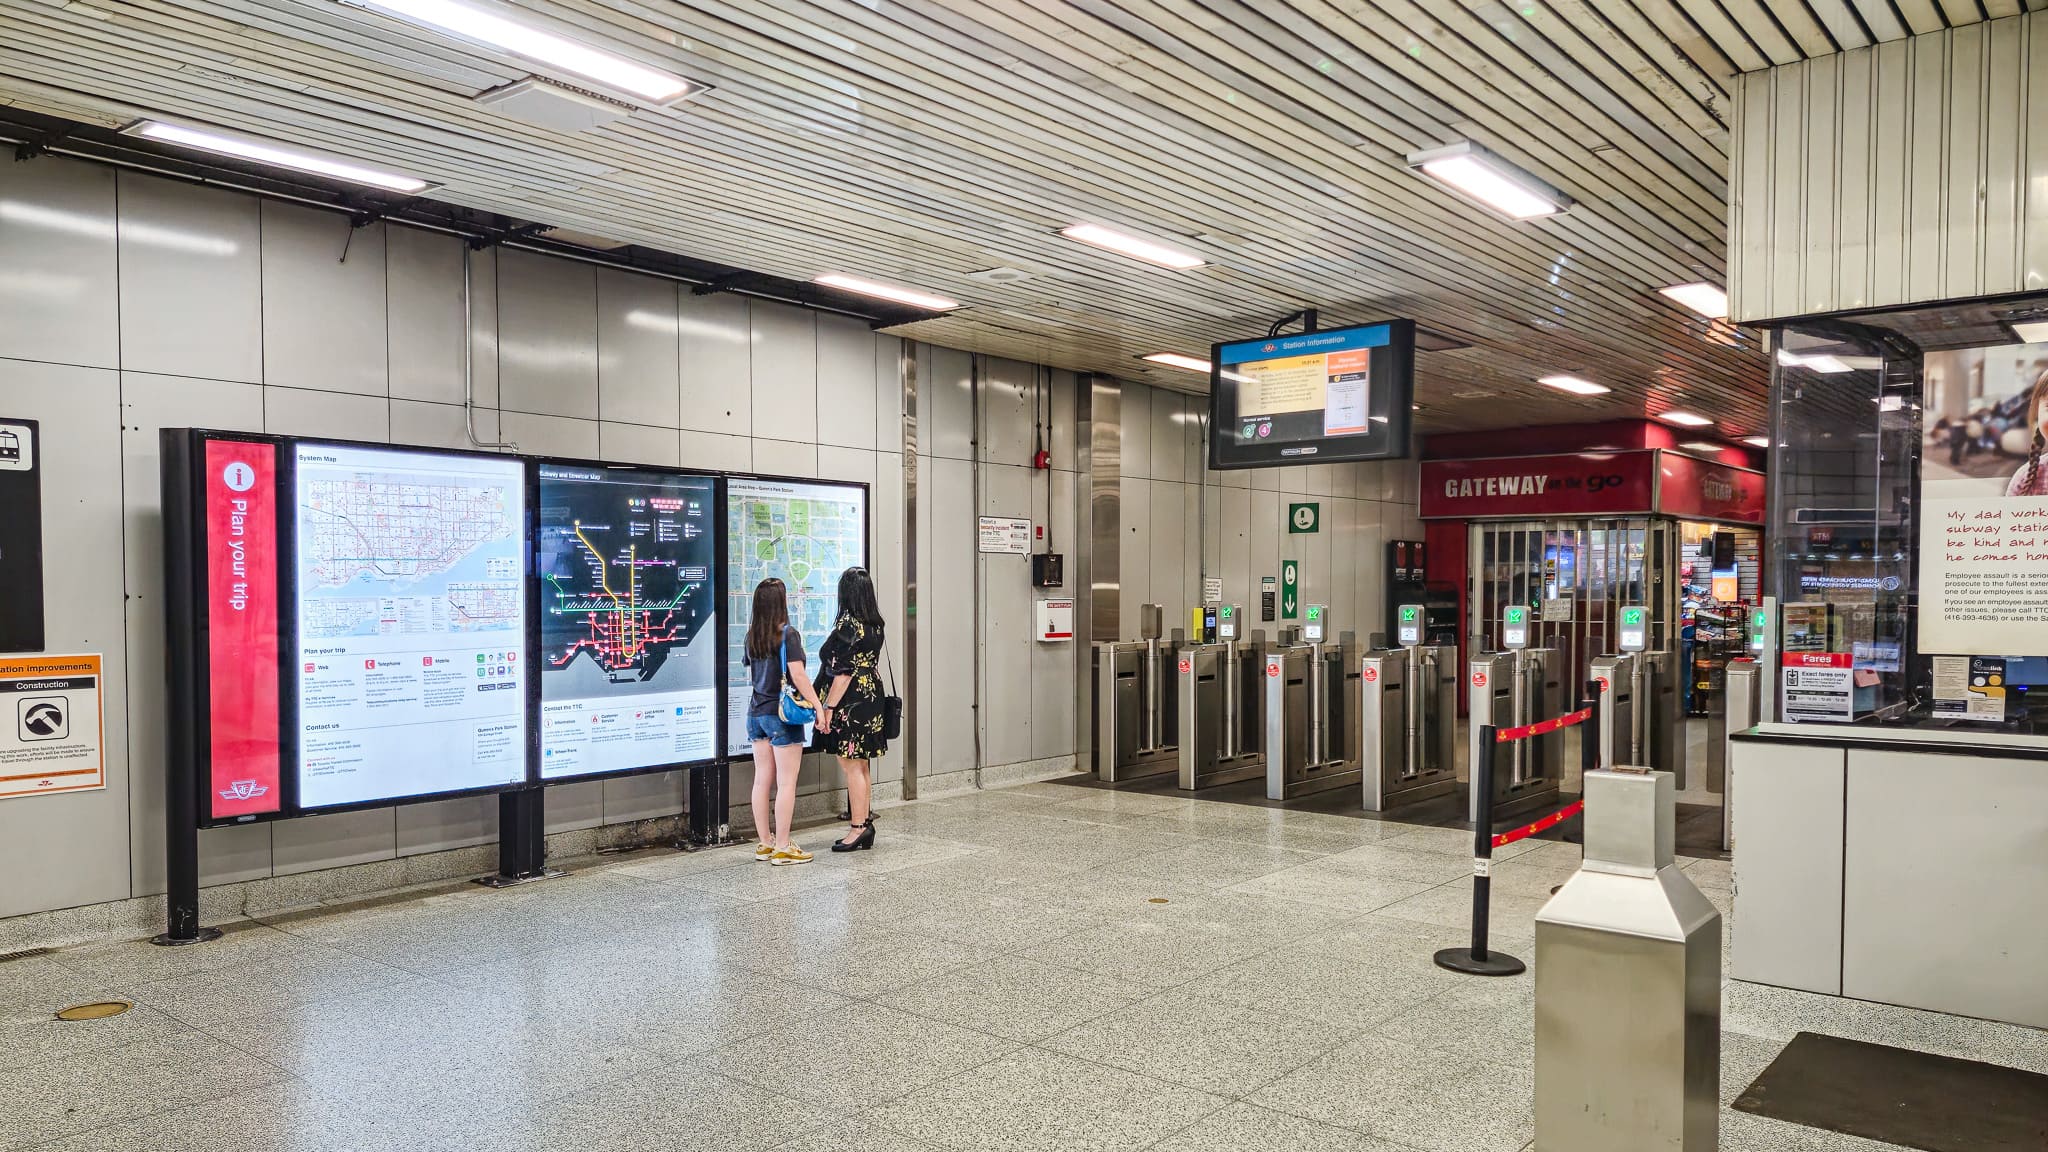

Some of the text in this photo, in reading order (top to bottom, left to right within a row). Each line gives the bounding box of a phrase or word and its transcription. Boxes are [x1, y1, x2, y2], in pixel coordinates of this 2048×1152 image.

[1307, 336, 1345, 346] Information
[1445, 475, 1548, 498] GATEWAY
[1586, 474, 1624, 492] go
[1947, 507, 2048, 521] My dad work
[1946, 525, 2001, 534] subway
[1947, 539, 1966, 547] be
[1974, 537, 2000, 547] kind
[2009, 538, 2034, 547] and
[228, 500, 249, 610] Plan your trip
[1946, 553, 1964, 561] he
[1983, 589, 2024, 597] employees
[1987, 599, 2022, 607] employee
[27, 663, 92, 673] improvements
[16, 681, 69, 690] Construction
